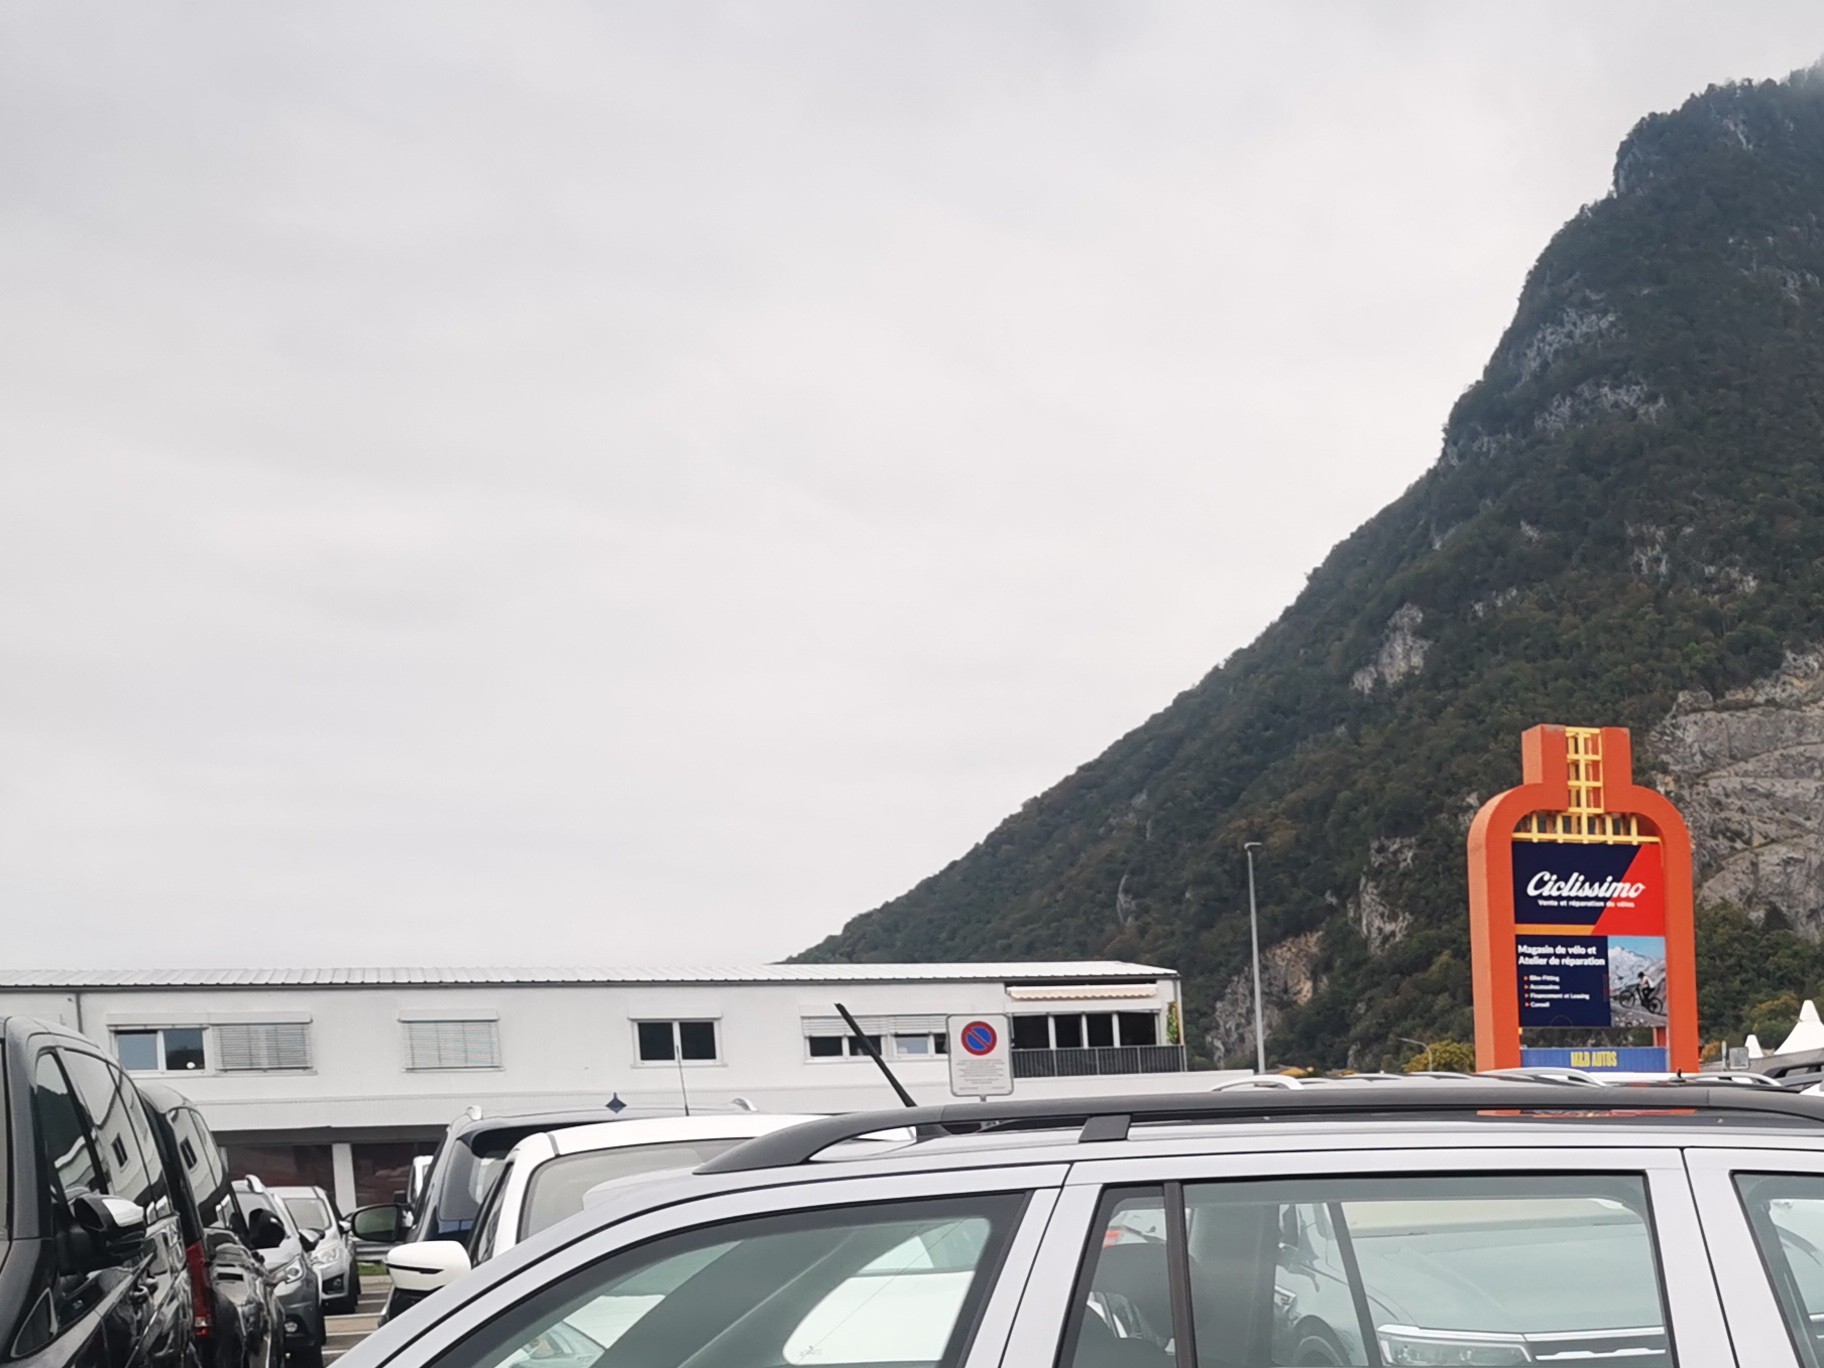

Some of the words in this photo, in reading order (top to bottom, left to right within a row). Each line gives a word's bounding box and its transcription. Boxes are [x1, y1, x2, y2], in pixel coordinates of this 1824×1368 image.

[1526, 870, 1646, 898] Ciclissimo
[1537, 899, 1559, 907] Vente
[1568, 900, 1605, 908] réparation
[1605, 900, 1615, 908] de
[1517, 944, 1555, 956] Magasin
[1555, 945, 1567, 955] de
[1567, 945, 1587, 955] vélo
[1587, 945, 1597, 955] et
[1518, 955, 1548, 966] Atelier
[1548, 956, 1561, 966] de
[1561, 956, 1606, 967] réparation
[1591, 1051, 1617, 1067] AUTOS
